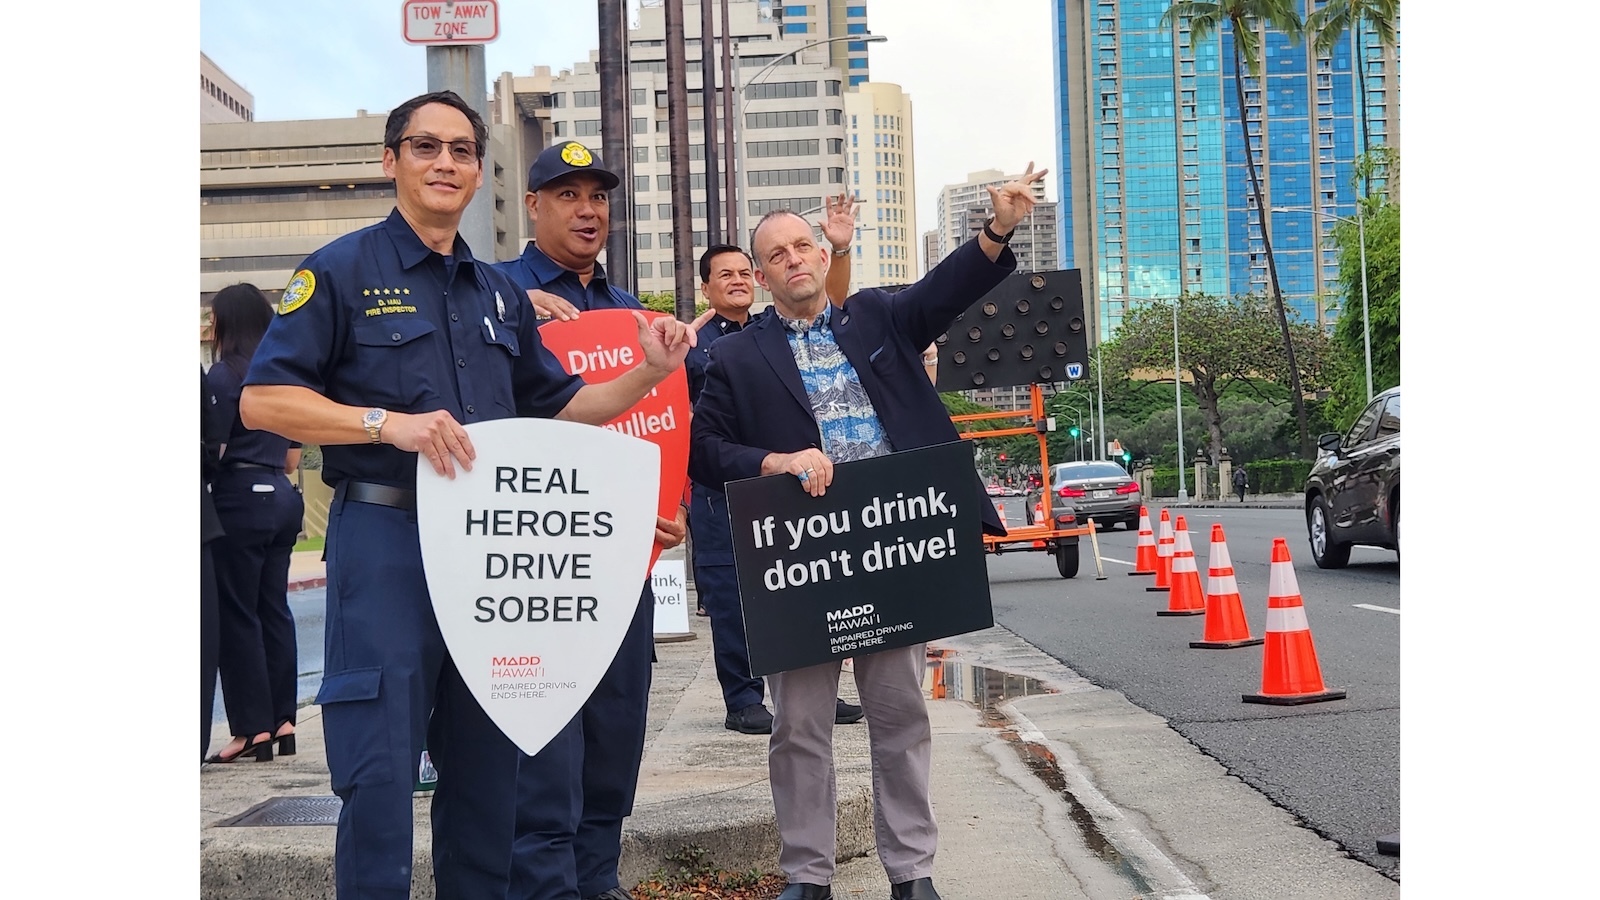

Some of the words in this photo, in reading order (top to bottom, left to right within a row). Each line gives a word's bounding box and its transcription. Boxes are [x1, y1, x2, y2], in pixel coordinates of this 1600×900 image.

[413, 6, 441, 20] TOW
[454, 5, 488, 19] AWAY
[434, 22, 468, 36] ZONE
[365, 308, 381, 317] FIRE
[382, 305, 417, 314] INSPECTOR
[567, 344, 634, 375] Drive
[495, 466, 589, 494] REAL
[466, 509, 613, 537] HEROES
[752, 515, 775, 549] If
[784, 509, 851, 550] you
[861, 486, 958, 529] drink,
[486, 553, 591, 579] DRIVE
[763, 550, 853, 591] don't
[862, 528, 957, 573] drive!
[474, 596, 598, 623] SOBER
[826, 604, 875, 622] MADD
[830, 630, 875, 645] IMPAIRED
[875, 622, 914, 636] DRIVING
[831, 642, 858, 653] ENDS
[858, 636, 887, 648] HERE.
[492, 656, 541, 666] MADD
